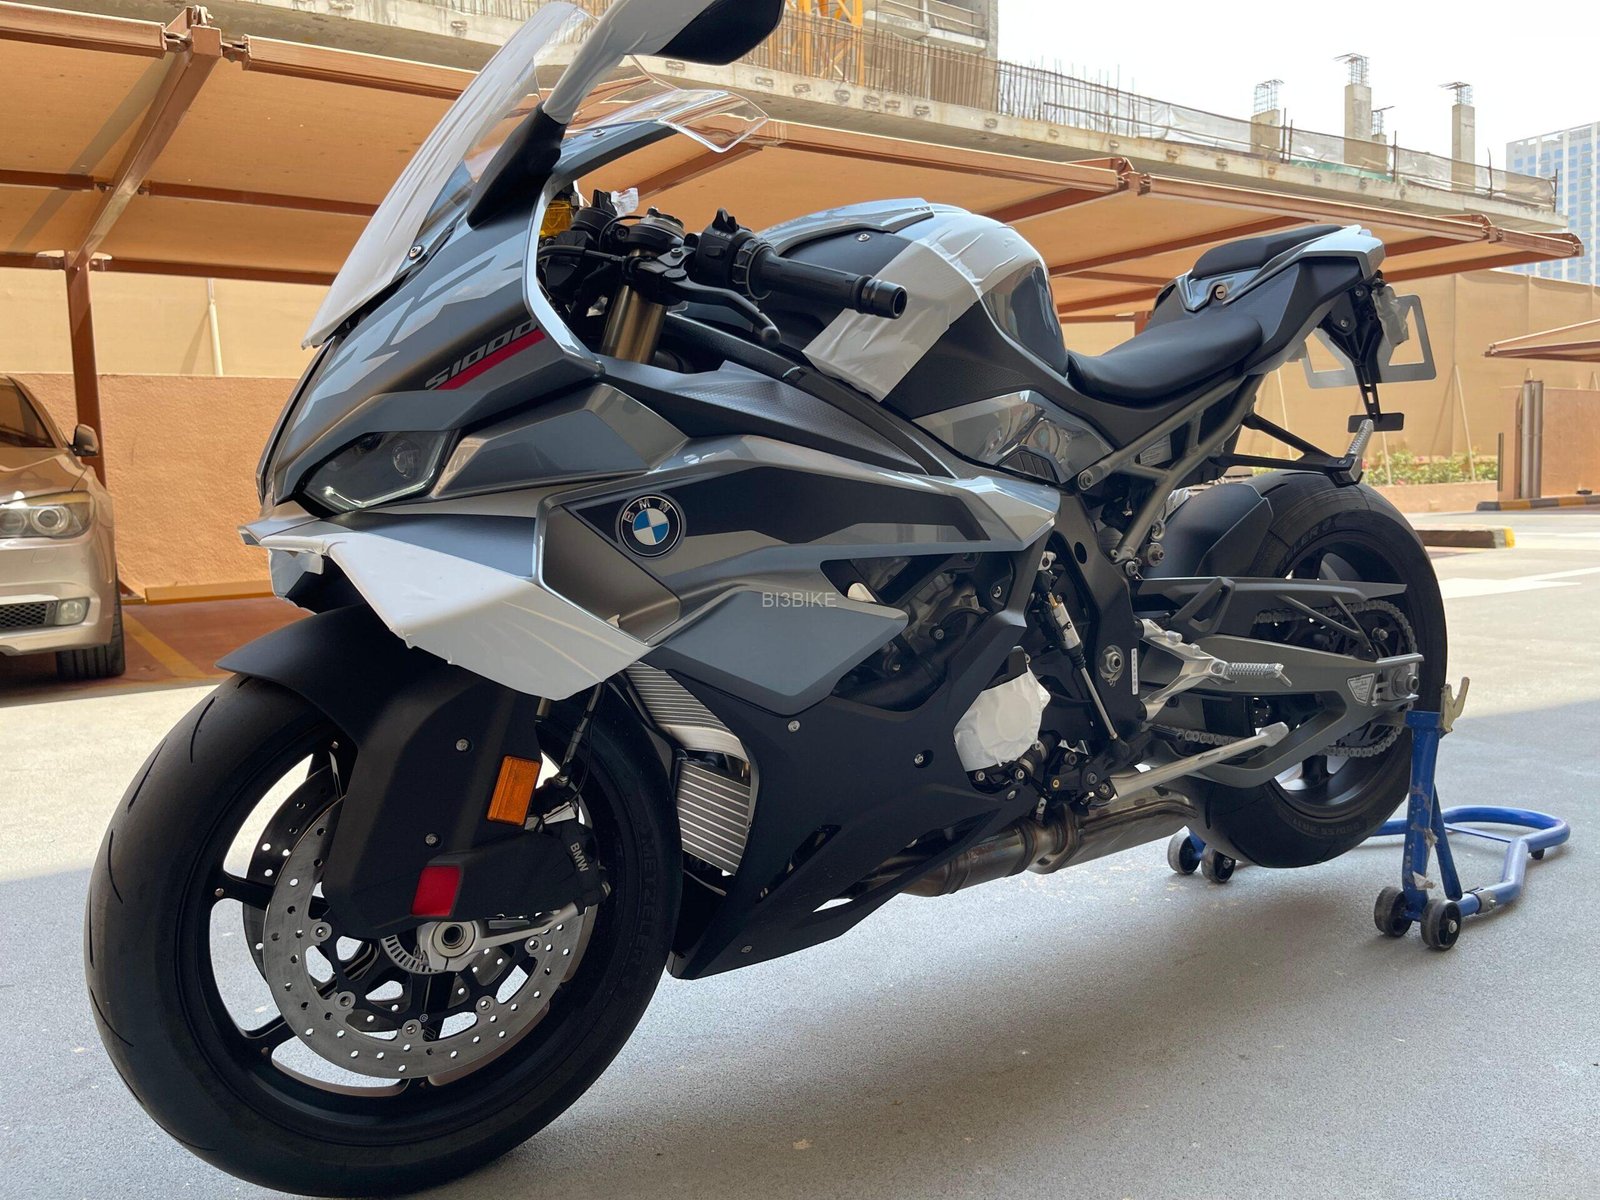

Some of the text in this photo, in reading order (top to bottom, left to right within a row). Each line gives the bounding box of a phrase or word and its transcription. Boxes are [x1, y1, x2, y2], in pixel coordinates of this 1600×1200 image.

[425, 320, 538, 390] S1000
[623, 498, 671, 523] BMW
[570, 842, 589, 872] BMW
